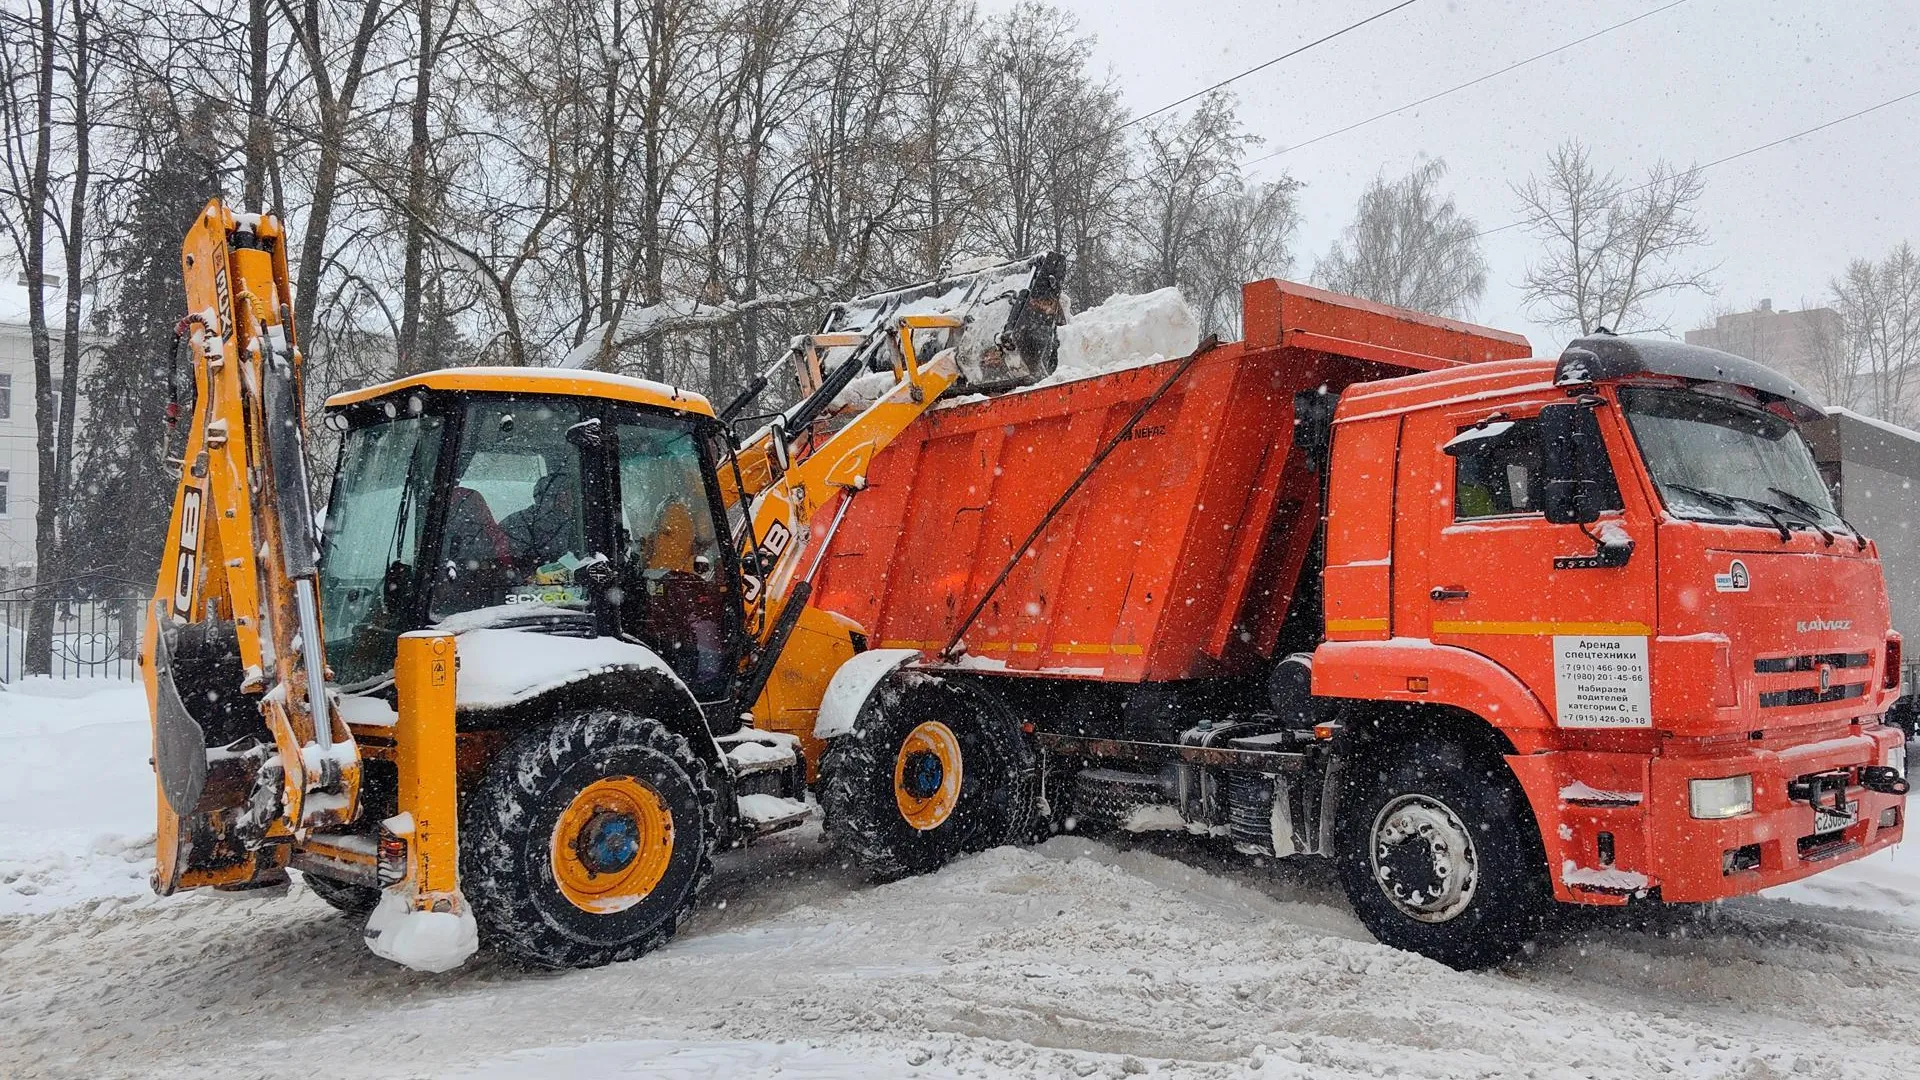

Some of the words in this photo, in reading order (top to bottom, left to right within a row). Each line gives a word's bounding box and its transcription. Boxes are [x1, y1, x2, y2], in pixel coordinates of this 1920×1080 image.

[1134, 425, 1166, 439] NEFAZ
[742, 522, 791, 601] JB
[1556, 560, 1598, 568] 6520
[1796, 620, 1852, 633] KAMAZ
[1579, 640, 1621, 650] Аренда
[1565, 651, 1637, 660] спецтехники
[1572, 664, 1595, 672] (910)
[1573, 673, 1596, 681] (980)
[1597, 673, 1643, 682] 201-45-66
[1577, 685, 1627, 694] Набираем
[1577, 694, 1628, 702] водителей
[1568, 703, 1617, 711] категории
[1575, 714, 1598, 723] (915)
[1599, 715, 1646, 725] 426-90-18
